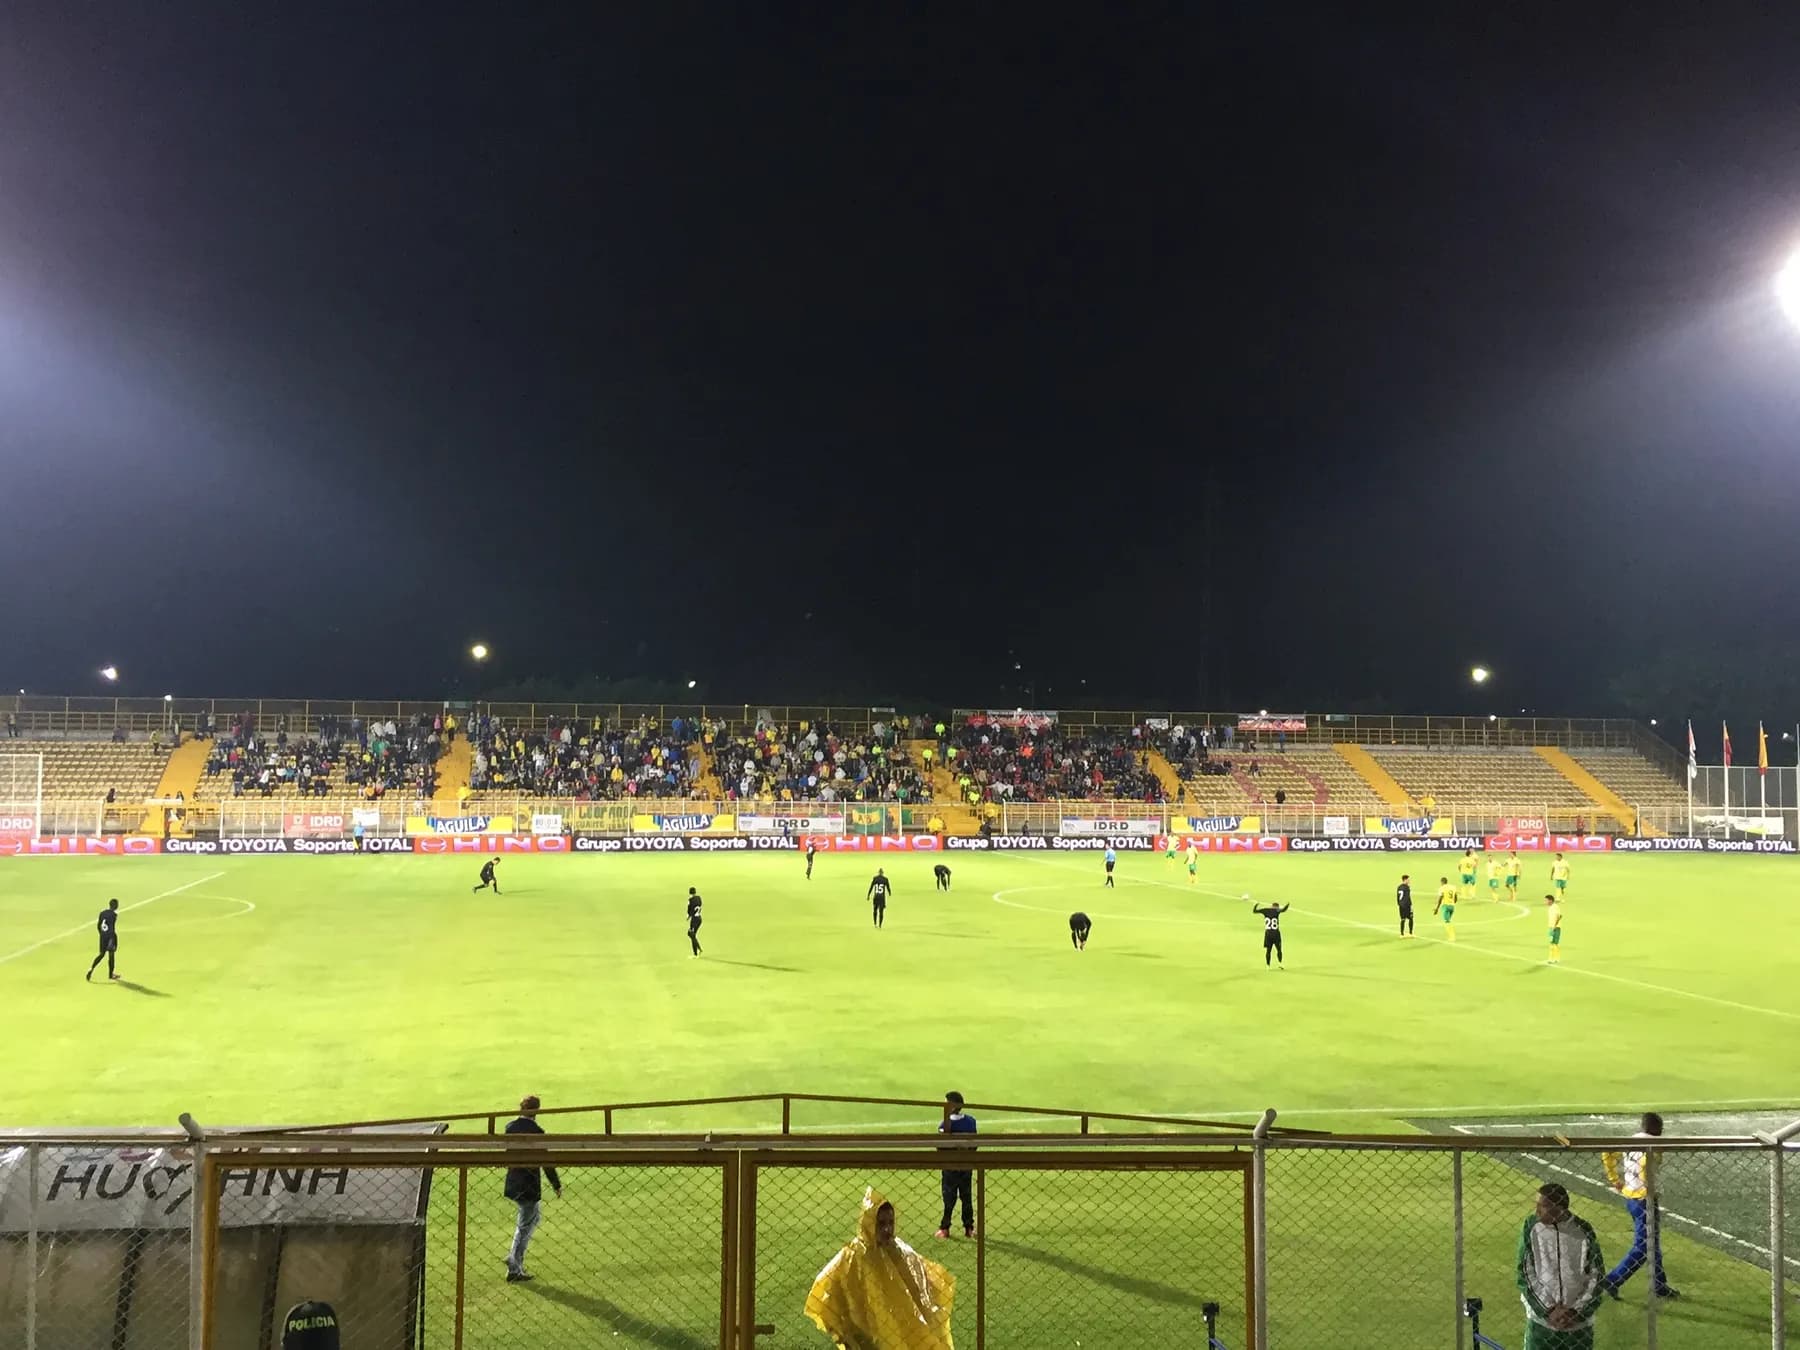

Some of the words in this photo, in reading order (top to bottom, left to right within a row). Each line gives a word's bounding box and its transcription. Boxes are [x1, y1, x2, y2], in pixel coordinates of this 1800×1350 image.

[310, 815, 343, 827] IDRD
[772, 819, 810, 828] IDRD
[1093, 821, 1129, 830] IDRD
[1518, 819, 1544, 829] IDRD
[30, 837, 155, 853] HINO
[166, 839, 216, 853] Grupo
[219, 839, 287, 851] TOYOTA
[294, 839, 355, 853] Soporte
[362, 838, 413, 850] TOTAL
[453, 837, 566, 852] HINO
[576, 837, 621, 852] Grupo
[623, 837, 684, 849] TOYOTA
[690, 836, 747, 851] Soporte
[750, 836, 798, 848] TOTAL
[835, 836, 938, 849] HINO
[947, 837, 988, 851] Grupo
[991, 837, 1047, 848] TOYOTA
[1052, 836, 1105, 850] Soporte
[1107, 836, 1152, 848] TOTAL
[1186, 837, 1282, 850] HINO
[1291, 838, 1330, 851] Grupo
[1332, 838, 1385, 849] TOYOTA
[1390, 837, 1439, 850] Soporte
[1442, 837, 1484, 848] TOTAL
[1516, 837, 1606, 849] HINO
[1614, 839, 1651, 851] Grupo
[1653, 839, 1703, 849] TOYOTA
[1707, 839, 1753, 852] Soporte
[1755, 840, 1796, 851] TOTAL
[875, 883, 884, 894] 15
[1398, 890, 1404, 900] 7
[101, 919, 109, 931] 6
[1264, 917, 1278, 930] 28
[289, 1316, 335, 1331] POLICIA
